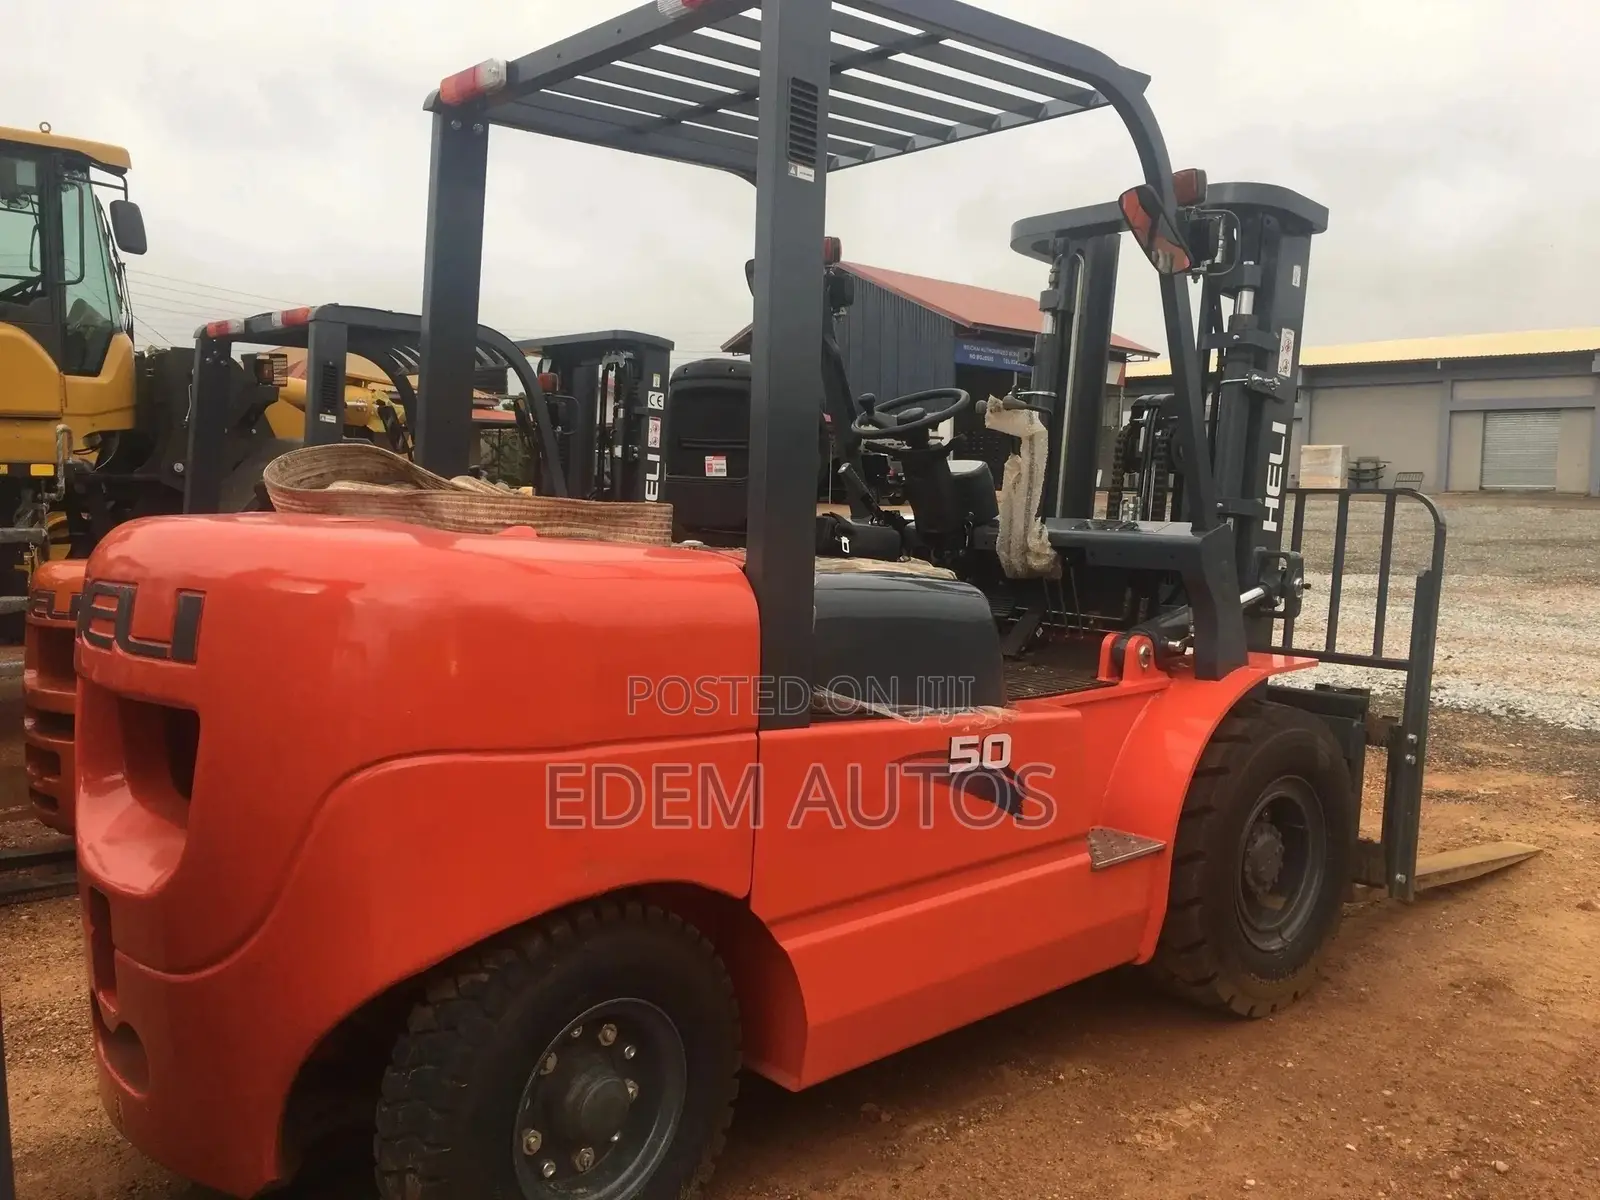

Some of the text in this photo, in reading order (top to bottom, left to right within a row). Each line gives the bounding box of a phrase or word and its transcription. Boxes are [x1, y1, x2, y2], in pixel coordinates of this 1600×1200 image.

[649, 393, 663, 408] CE
[645, 453, 661, 503] ELI
[1262, 421, 1287, 532] HELI
[77, 580, 206, 665] ELI
[949, 733, 1012, 774] 50
